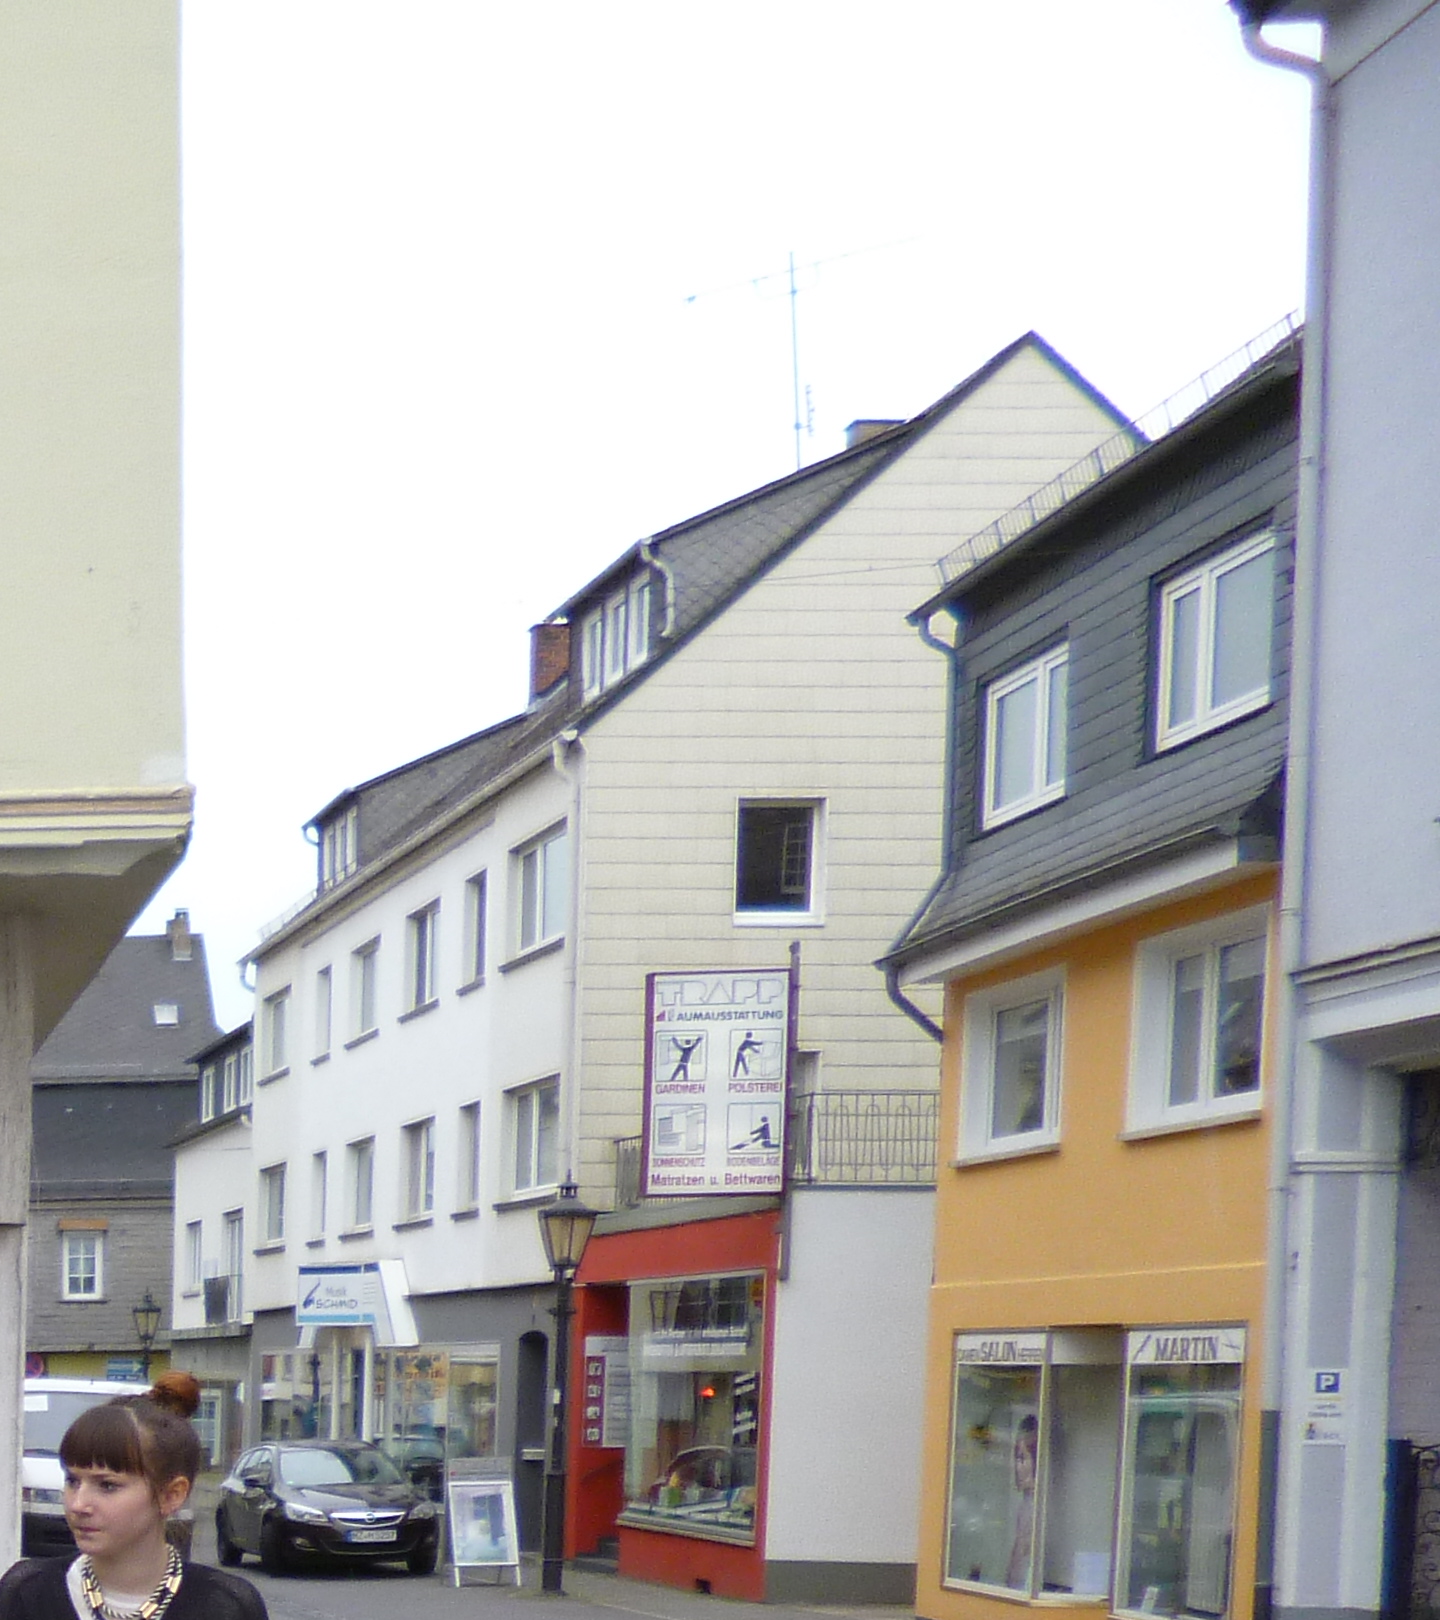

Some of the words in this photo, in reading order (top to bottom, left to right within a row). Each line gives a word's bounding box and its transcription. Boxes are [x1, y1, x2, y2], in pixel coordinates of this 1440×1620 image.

[656, 979, 784, 1006] TRAPP
[655, 1083, 705, 1094] GARDINEN
[728, 1081, 783, 1093] POLSTEREI
[651, 1174, 705, 1186] Matratzen
[725, 1173, 780, 1185] Bettwaren
[981, 1341, 1017, 1361] SALON
[1155, 1336, 1218, 1361] MARTIN
